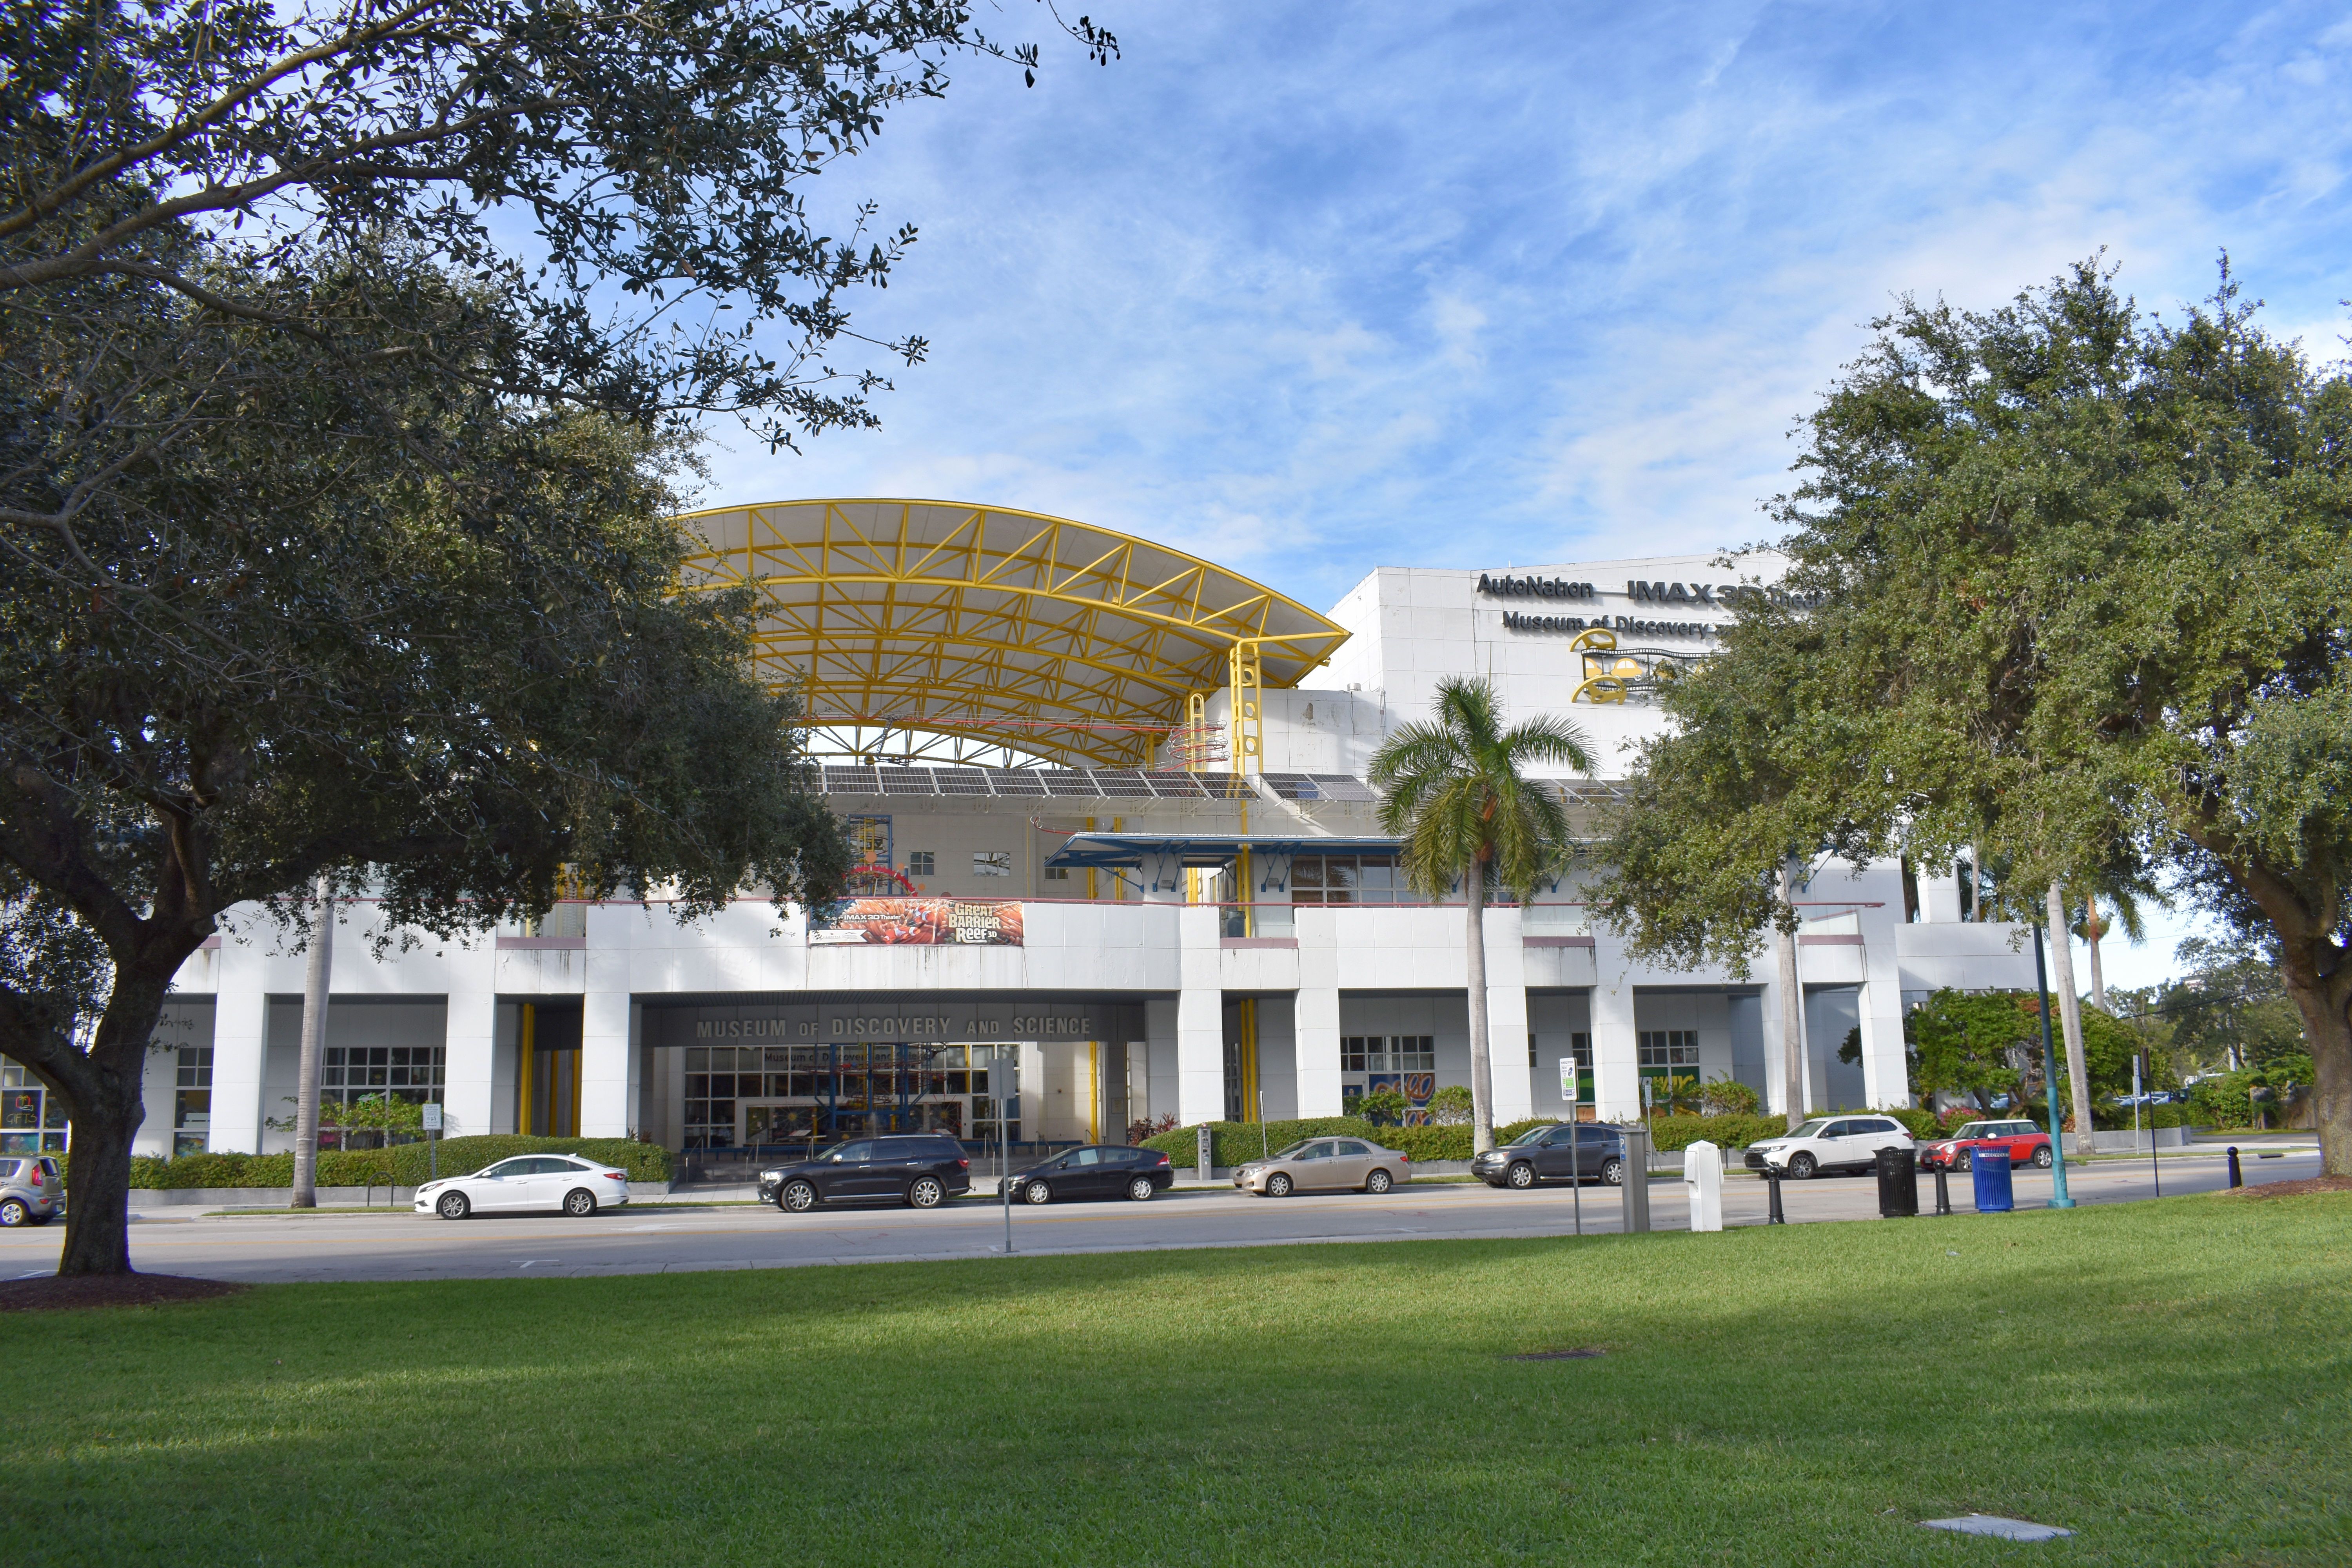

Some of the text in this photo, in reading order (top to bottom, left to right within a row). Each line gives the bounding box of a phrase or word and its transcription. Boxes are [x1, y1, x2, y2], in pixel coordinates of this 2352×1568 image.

[1477, 573, 1594, 598] AutoNation
[1627, 580, 1715, 603] IMAX
[1503, 611, 1585, 631] Museum
[1590, 615, 1609, 629] of
[1616, 615, 1709, 640] Discovery
[697, 1017, 1091, 1038] MUSEUM OF DISCOVERY AND SCIENCE
[6, 1113, 37, 1124] GIFTS
[1620, 1138, 1624, 1148] P
